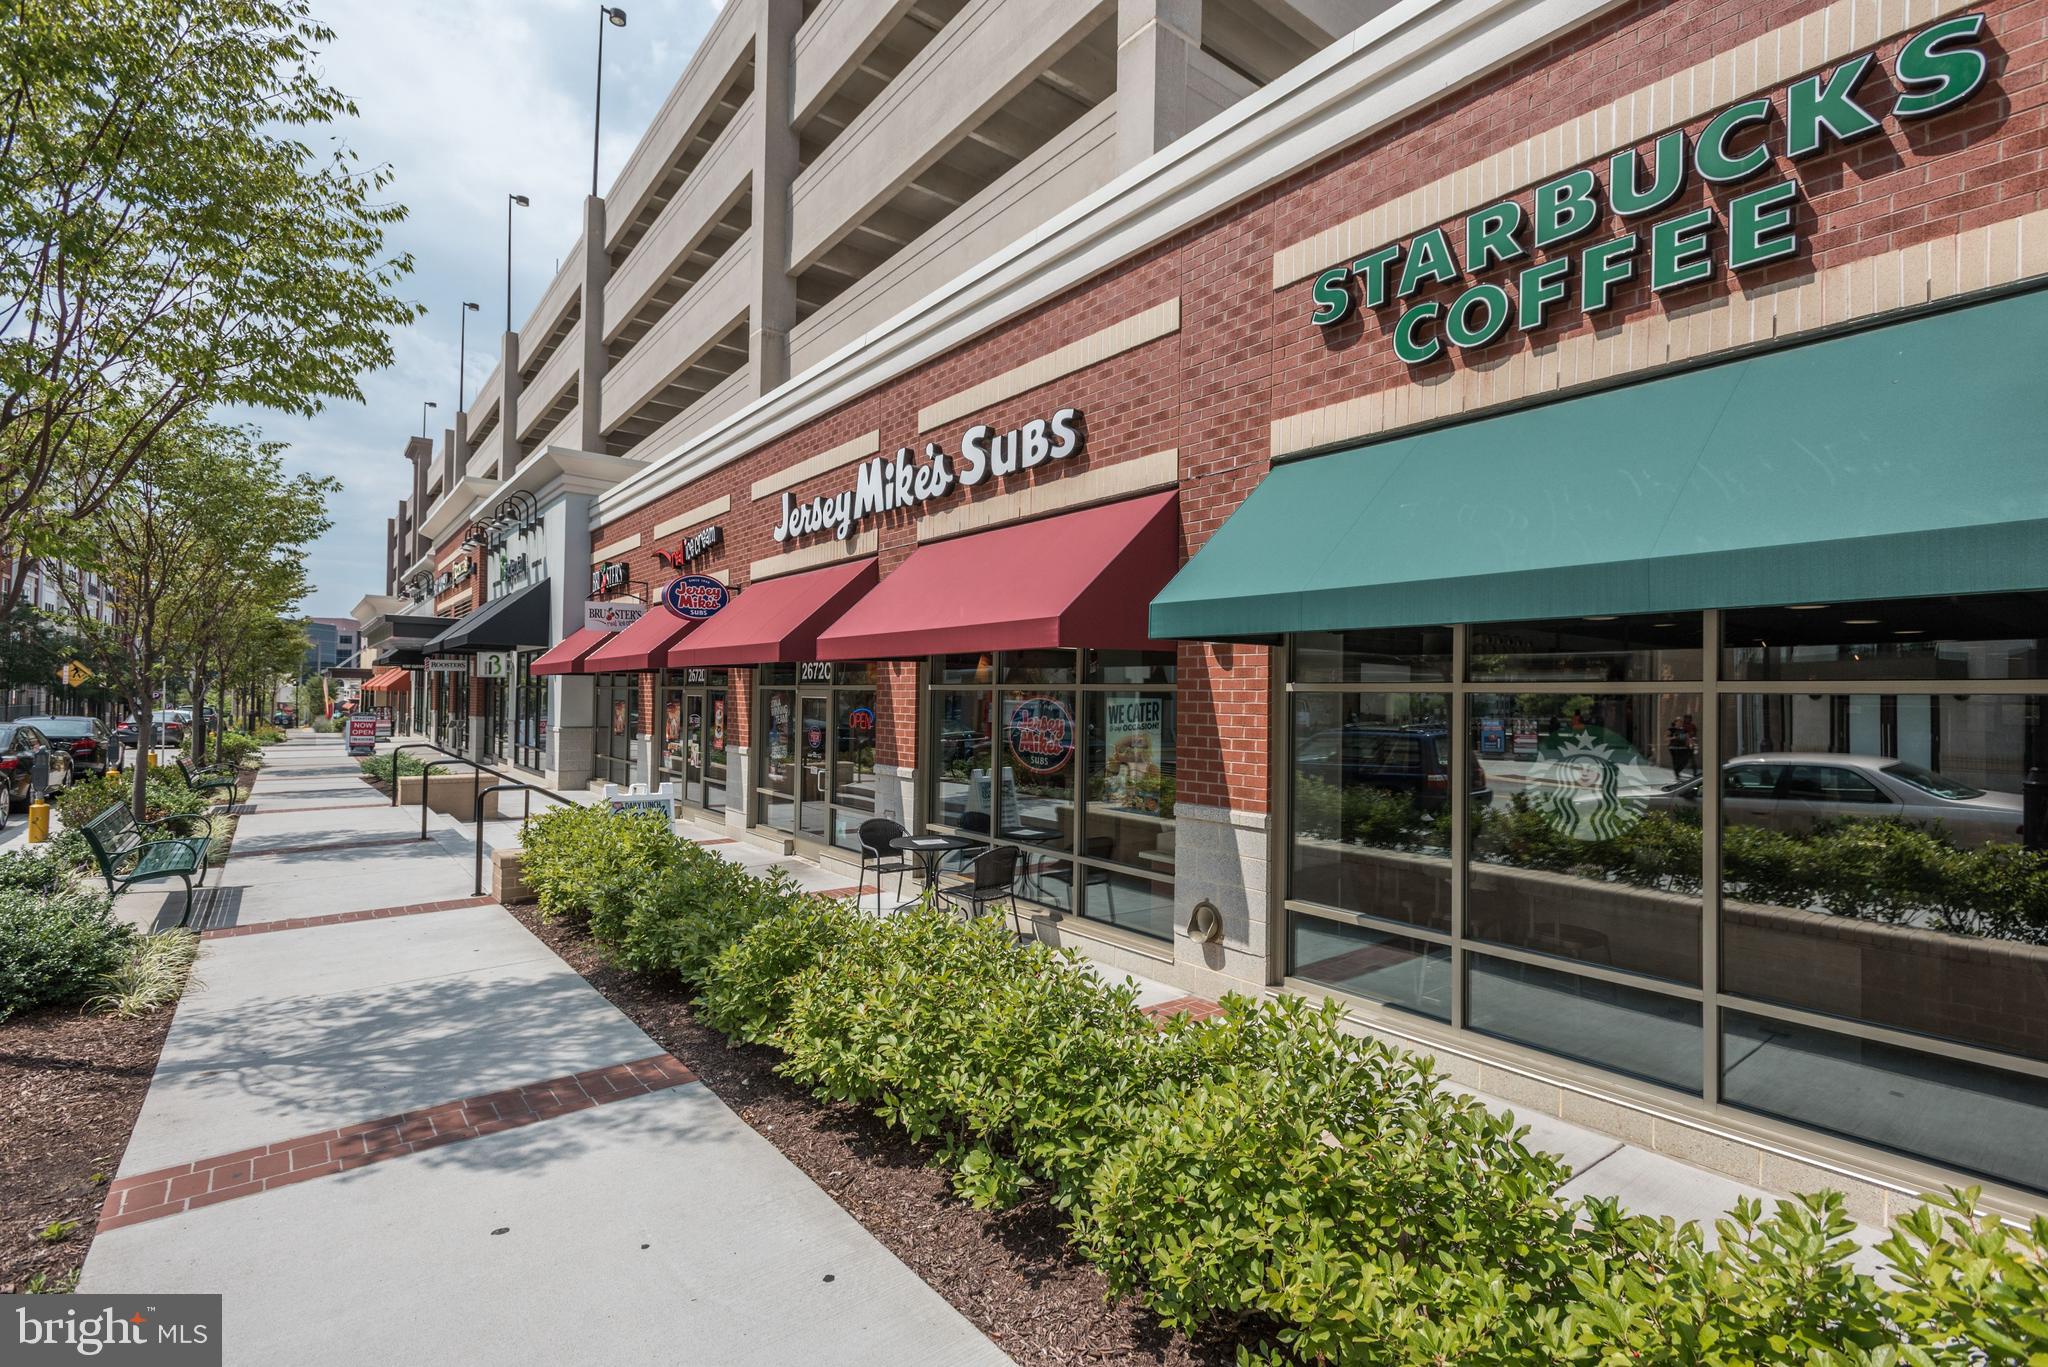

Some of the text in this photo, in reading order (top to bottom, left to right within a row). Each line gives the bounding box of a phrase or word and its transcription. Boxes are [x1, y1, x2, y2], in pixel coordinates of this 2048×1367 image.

[1311, 12, 1990, 327] STARBUCKS
[1393, 178, 1799, 365] COFFEE
[774, 408, 1081, 542] Jersey Mike's SUBS
[675, 582, 721, 600] Jersey
[430, 661, 466, 669] ROOSTERS
[802, 662, 832, 680] 2672C
[849, 711, 872, 730] OPEN
[1108, 701, 1160, 724] WE CATER
[1017, 710, 1065, 740] Jersey
[1030, 755, 1049, 765] SUBS
[642, 801, 661, 809] LUNCH
